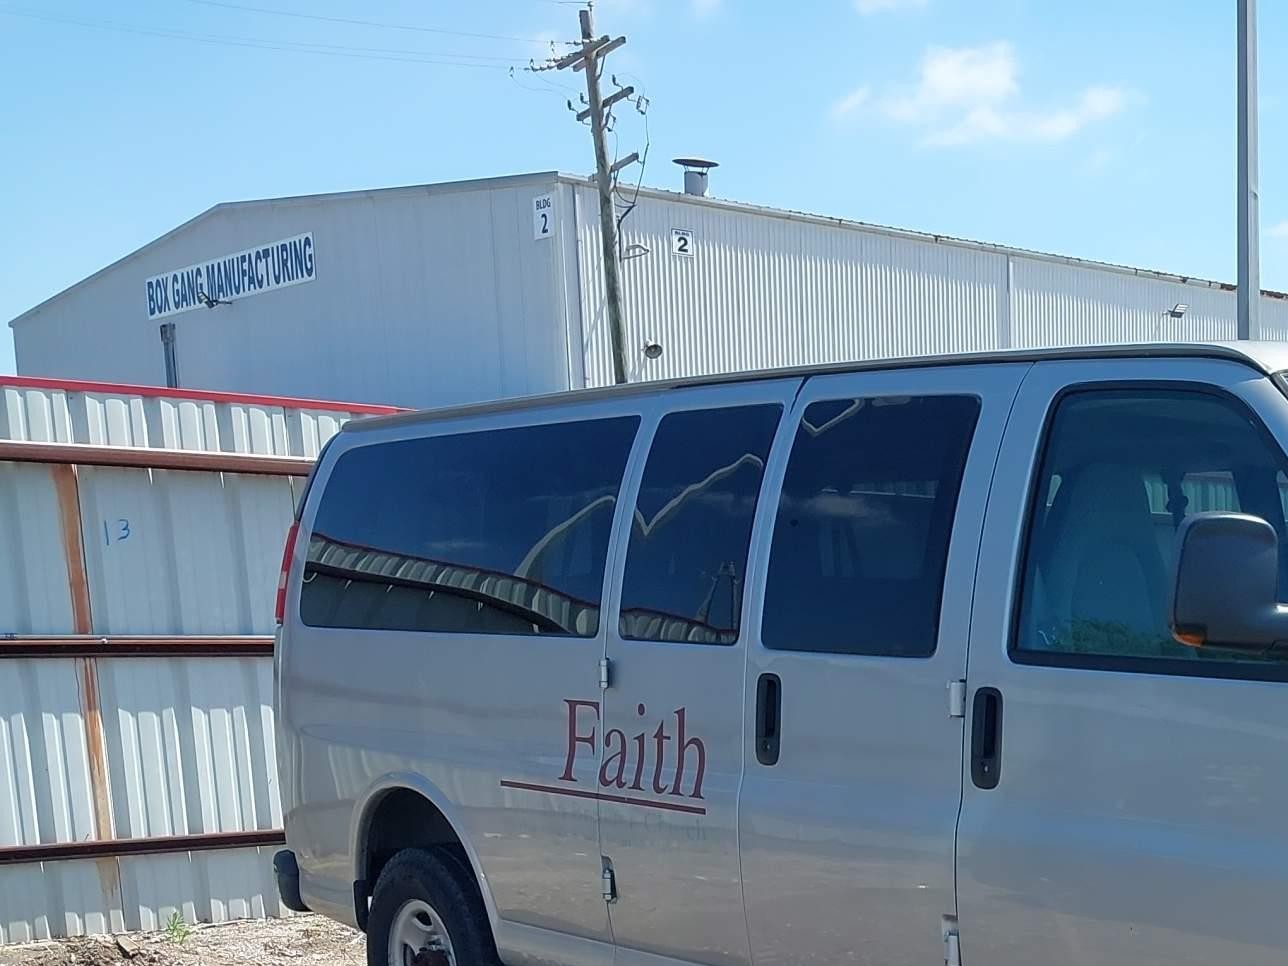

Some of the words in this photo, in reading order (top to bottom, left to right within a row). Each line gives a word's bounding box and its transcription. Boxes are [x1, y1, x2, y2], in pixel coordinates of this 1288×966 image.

[535, 198, 551, 211] BLDG
[541, 213, 549, 234] 2
[678, 236, 689, 253] 2
[147, 276, 171, 316] BOX
[172, 267, 204, 309] GANG
[205, 236, 314, 302] MANUFACTURING
[557, 699, 706, 800] Faith
